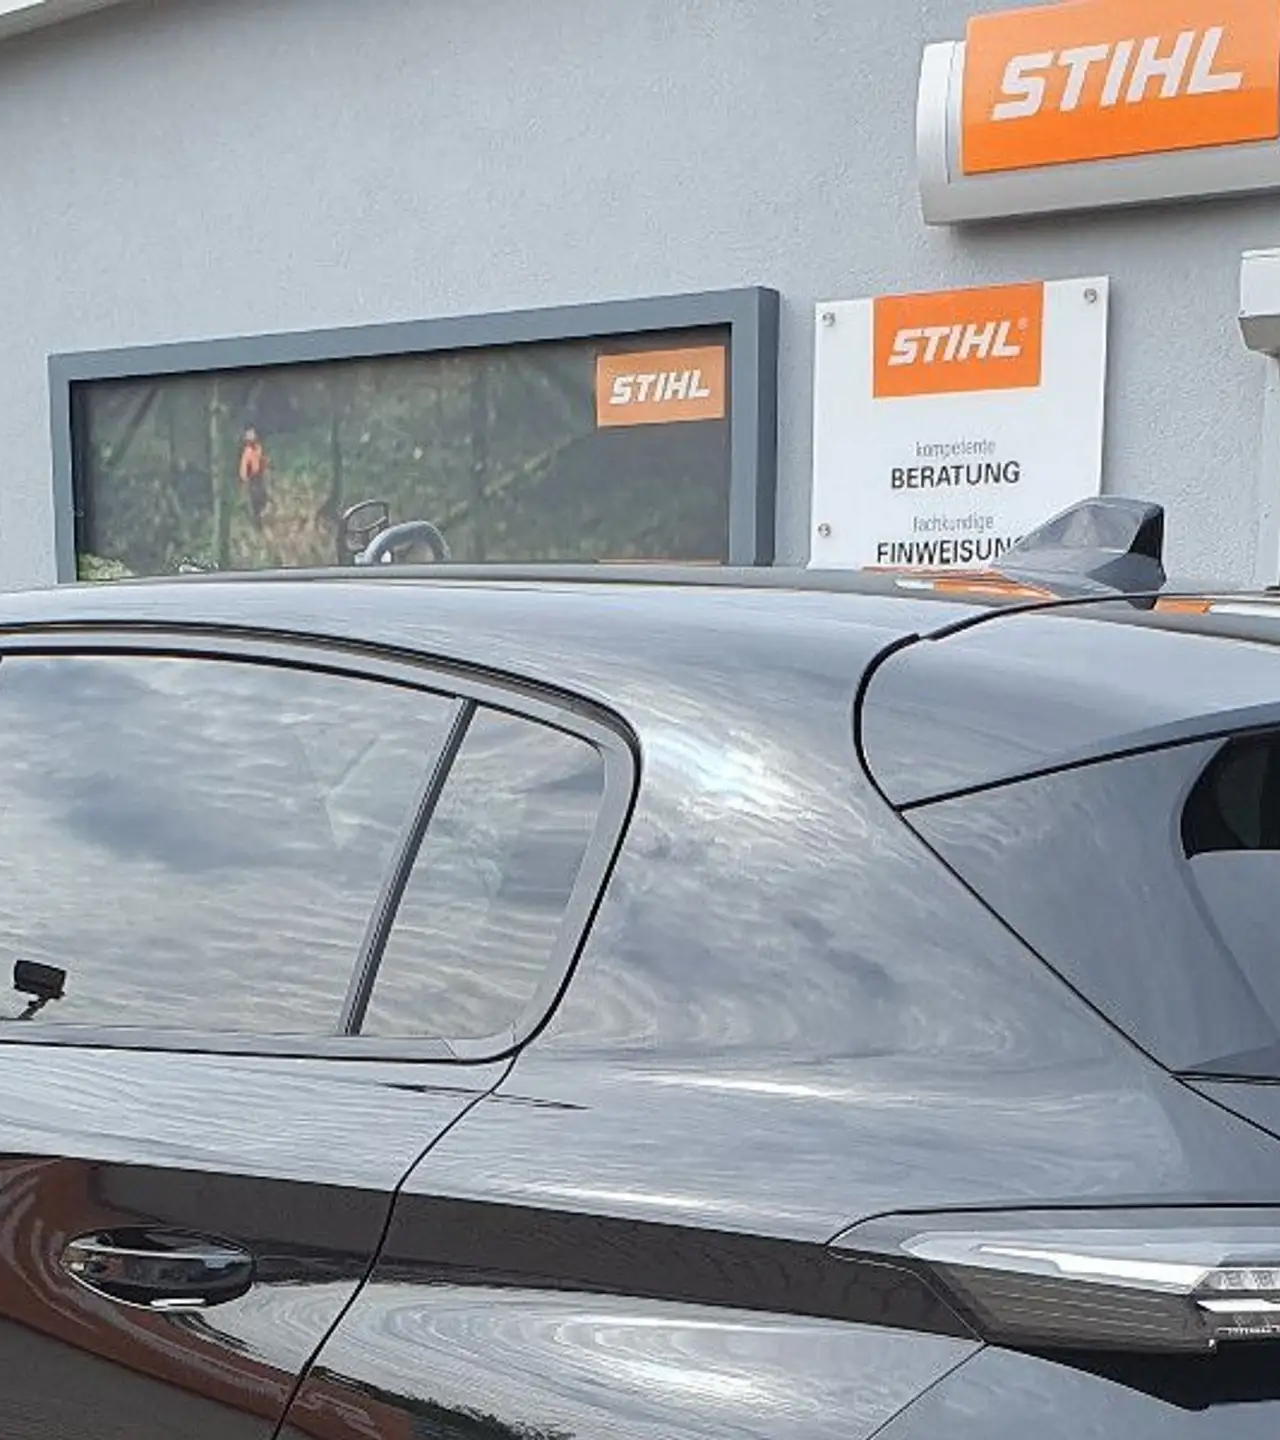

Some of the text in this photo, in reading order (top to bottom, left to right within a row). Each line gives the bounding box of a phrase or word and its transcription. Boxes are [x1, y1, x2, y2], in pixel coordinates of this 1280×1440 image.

[990, 26, 1243, 121] STIHL
[887, 320, 1022, 367] STIHL
[608, 369, 711, 405] STIHL
[891, 460, 1021, 489] BERATUNG
